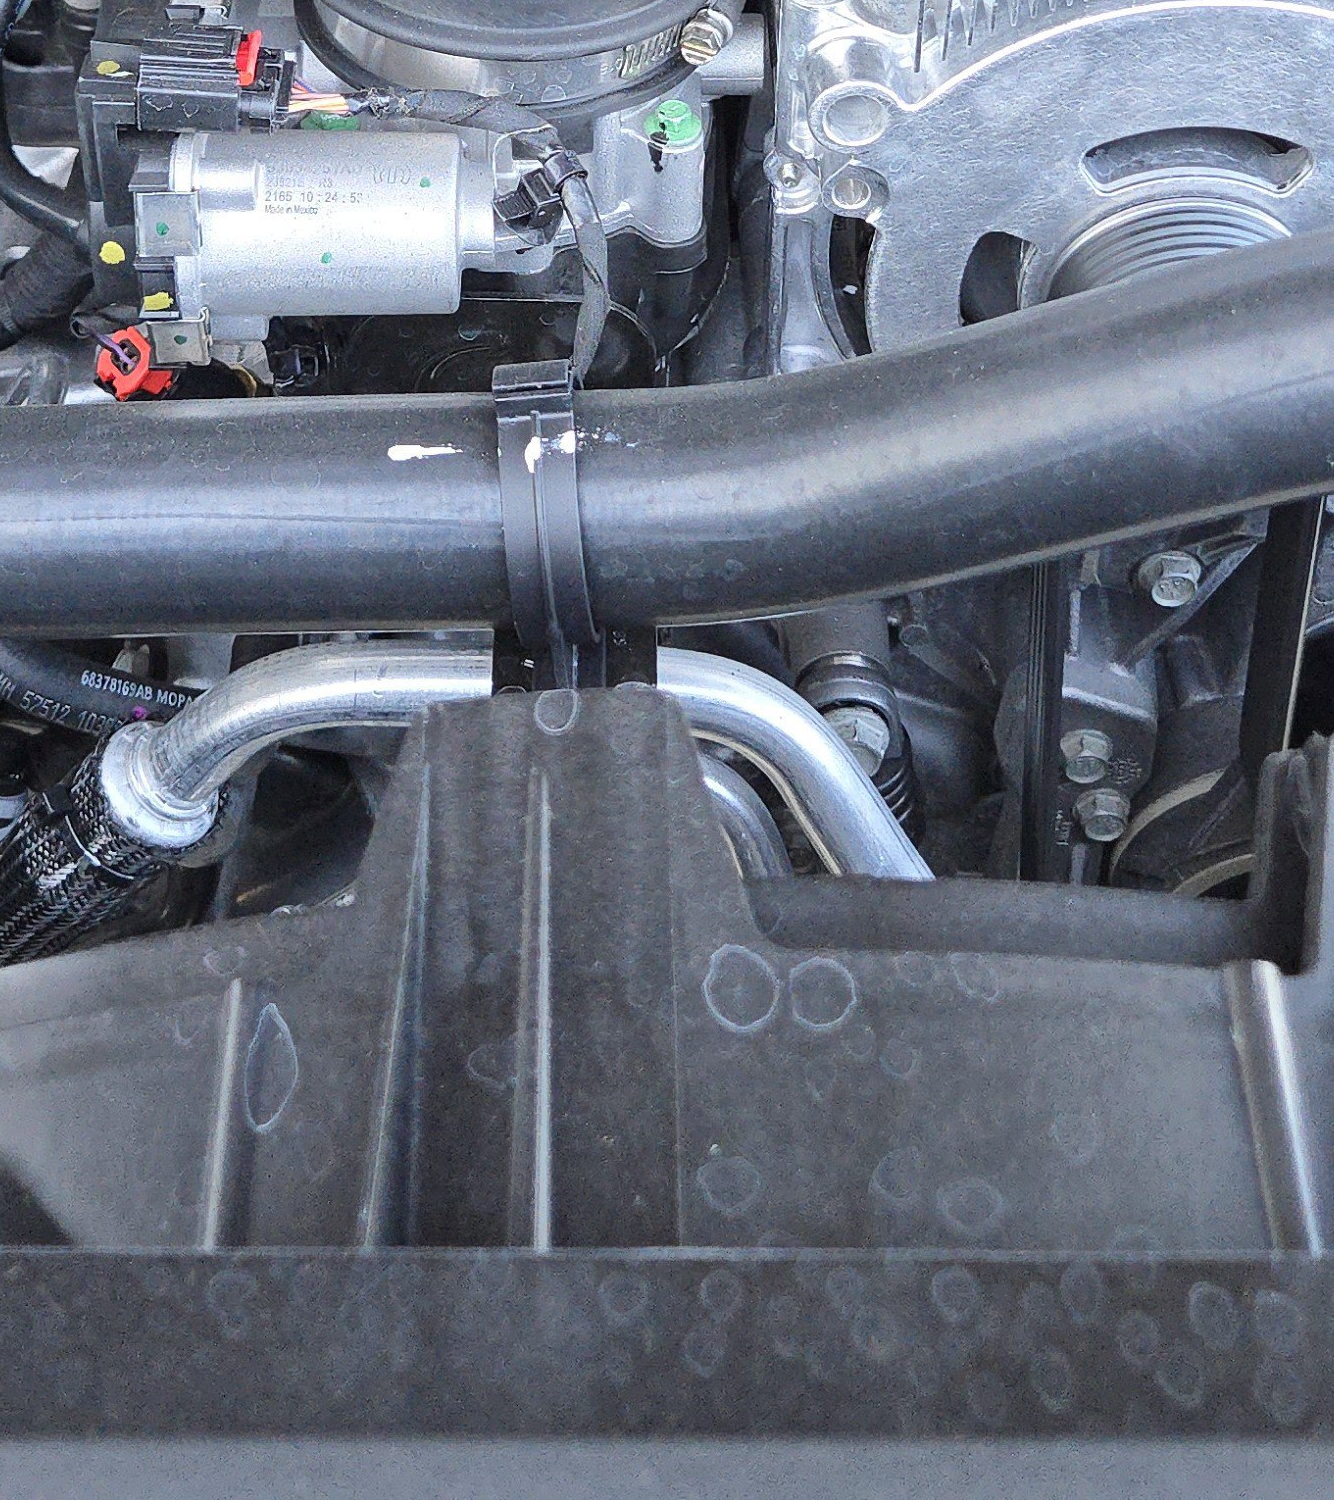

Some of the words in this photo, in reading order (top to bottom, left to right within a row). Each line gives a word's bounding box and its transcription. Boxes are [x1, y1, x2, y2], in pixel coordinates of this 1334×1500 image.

[265, 204, 284, 215] Made
[293, 204, 319, 216] Mexico
[81, 669, 154, 702] 68378169AB
[156, 690, 199, 710] MOPA
